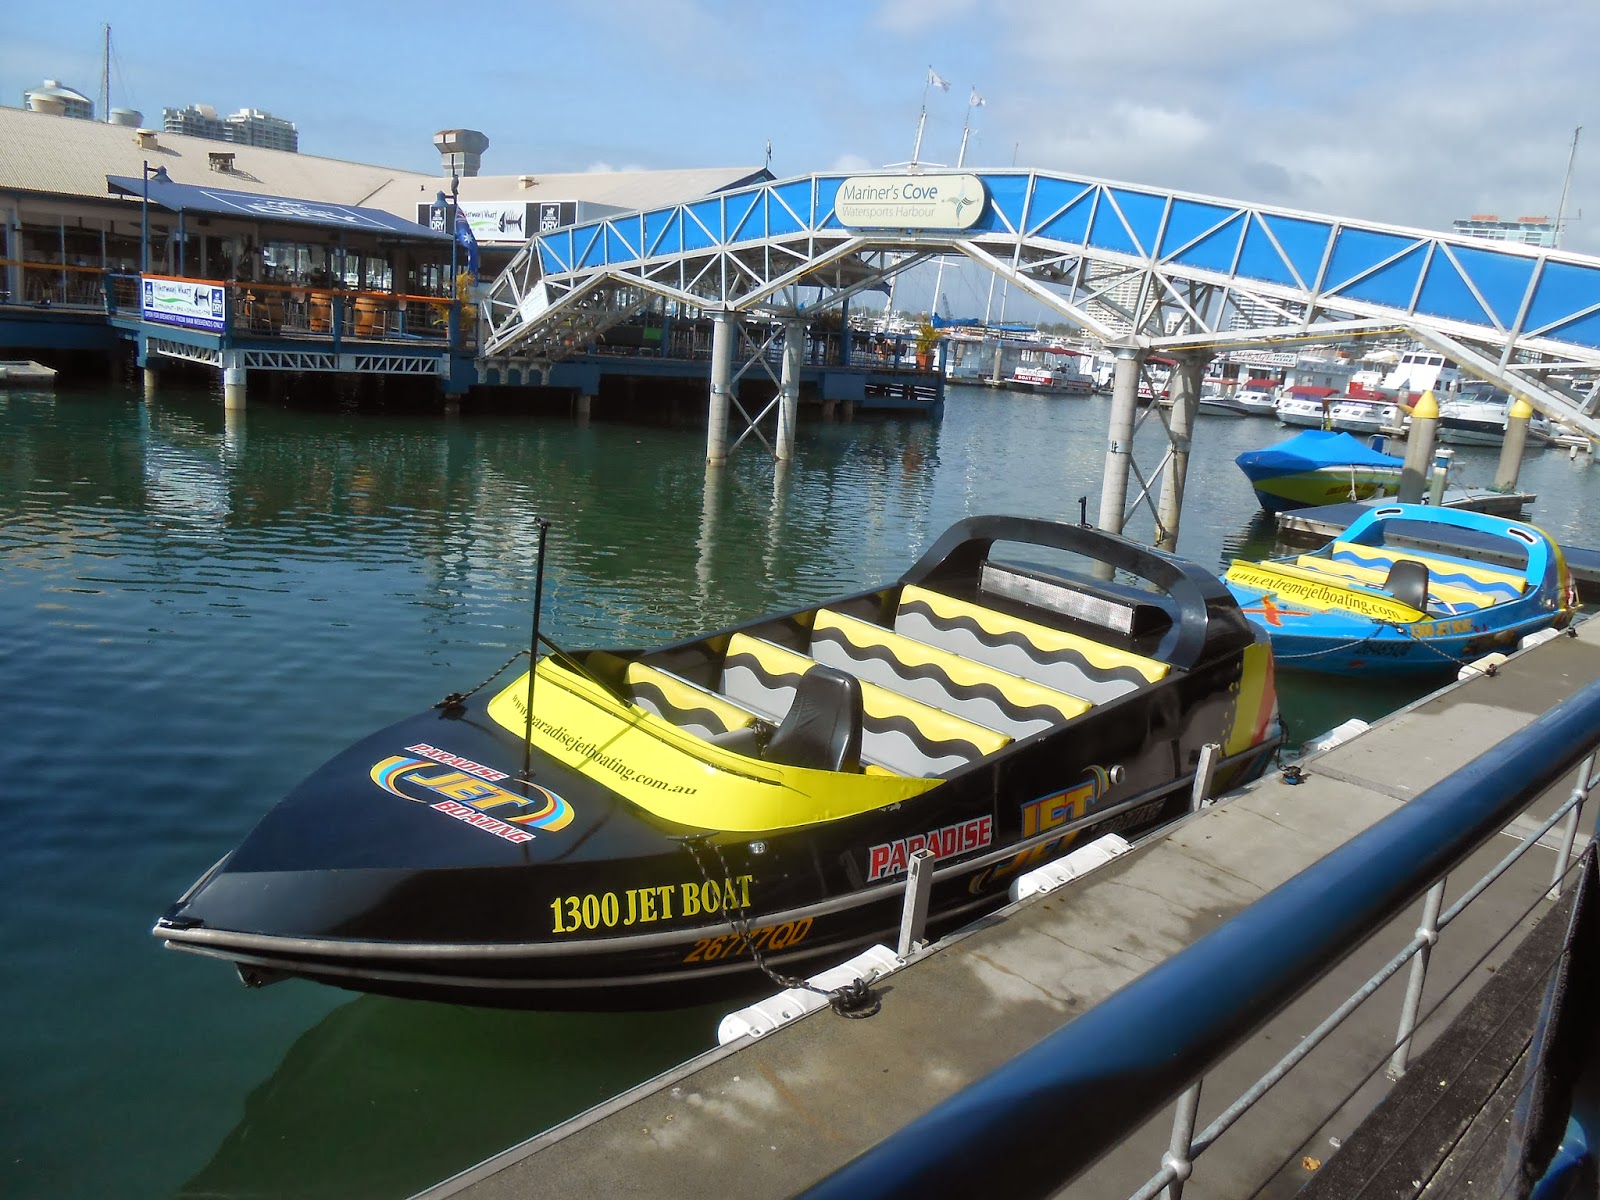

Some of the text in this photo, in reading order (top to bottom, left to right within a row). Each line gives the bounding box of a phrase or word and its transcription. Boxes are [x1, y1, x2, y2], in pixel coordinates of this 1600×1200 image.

[842, 206, 936, 219] Watersports Harbour
[843, 183, 938, 200] Mariner's Cove
[541, 220, 558, 231] DRY
[1231, 572, 1401, 620] www.extremejetboating.com
[404, 742, 510, 781] PARADISE
[402, 769, 535, 811] JET
[430, 800, 536, 845] BOATING
[550, 875, 753, 933] 1300 JET BOAT
[683, 917, 814, 963] 26777QD
